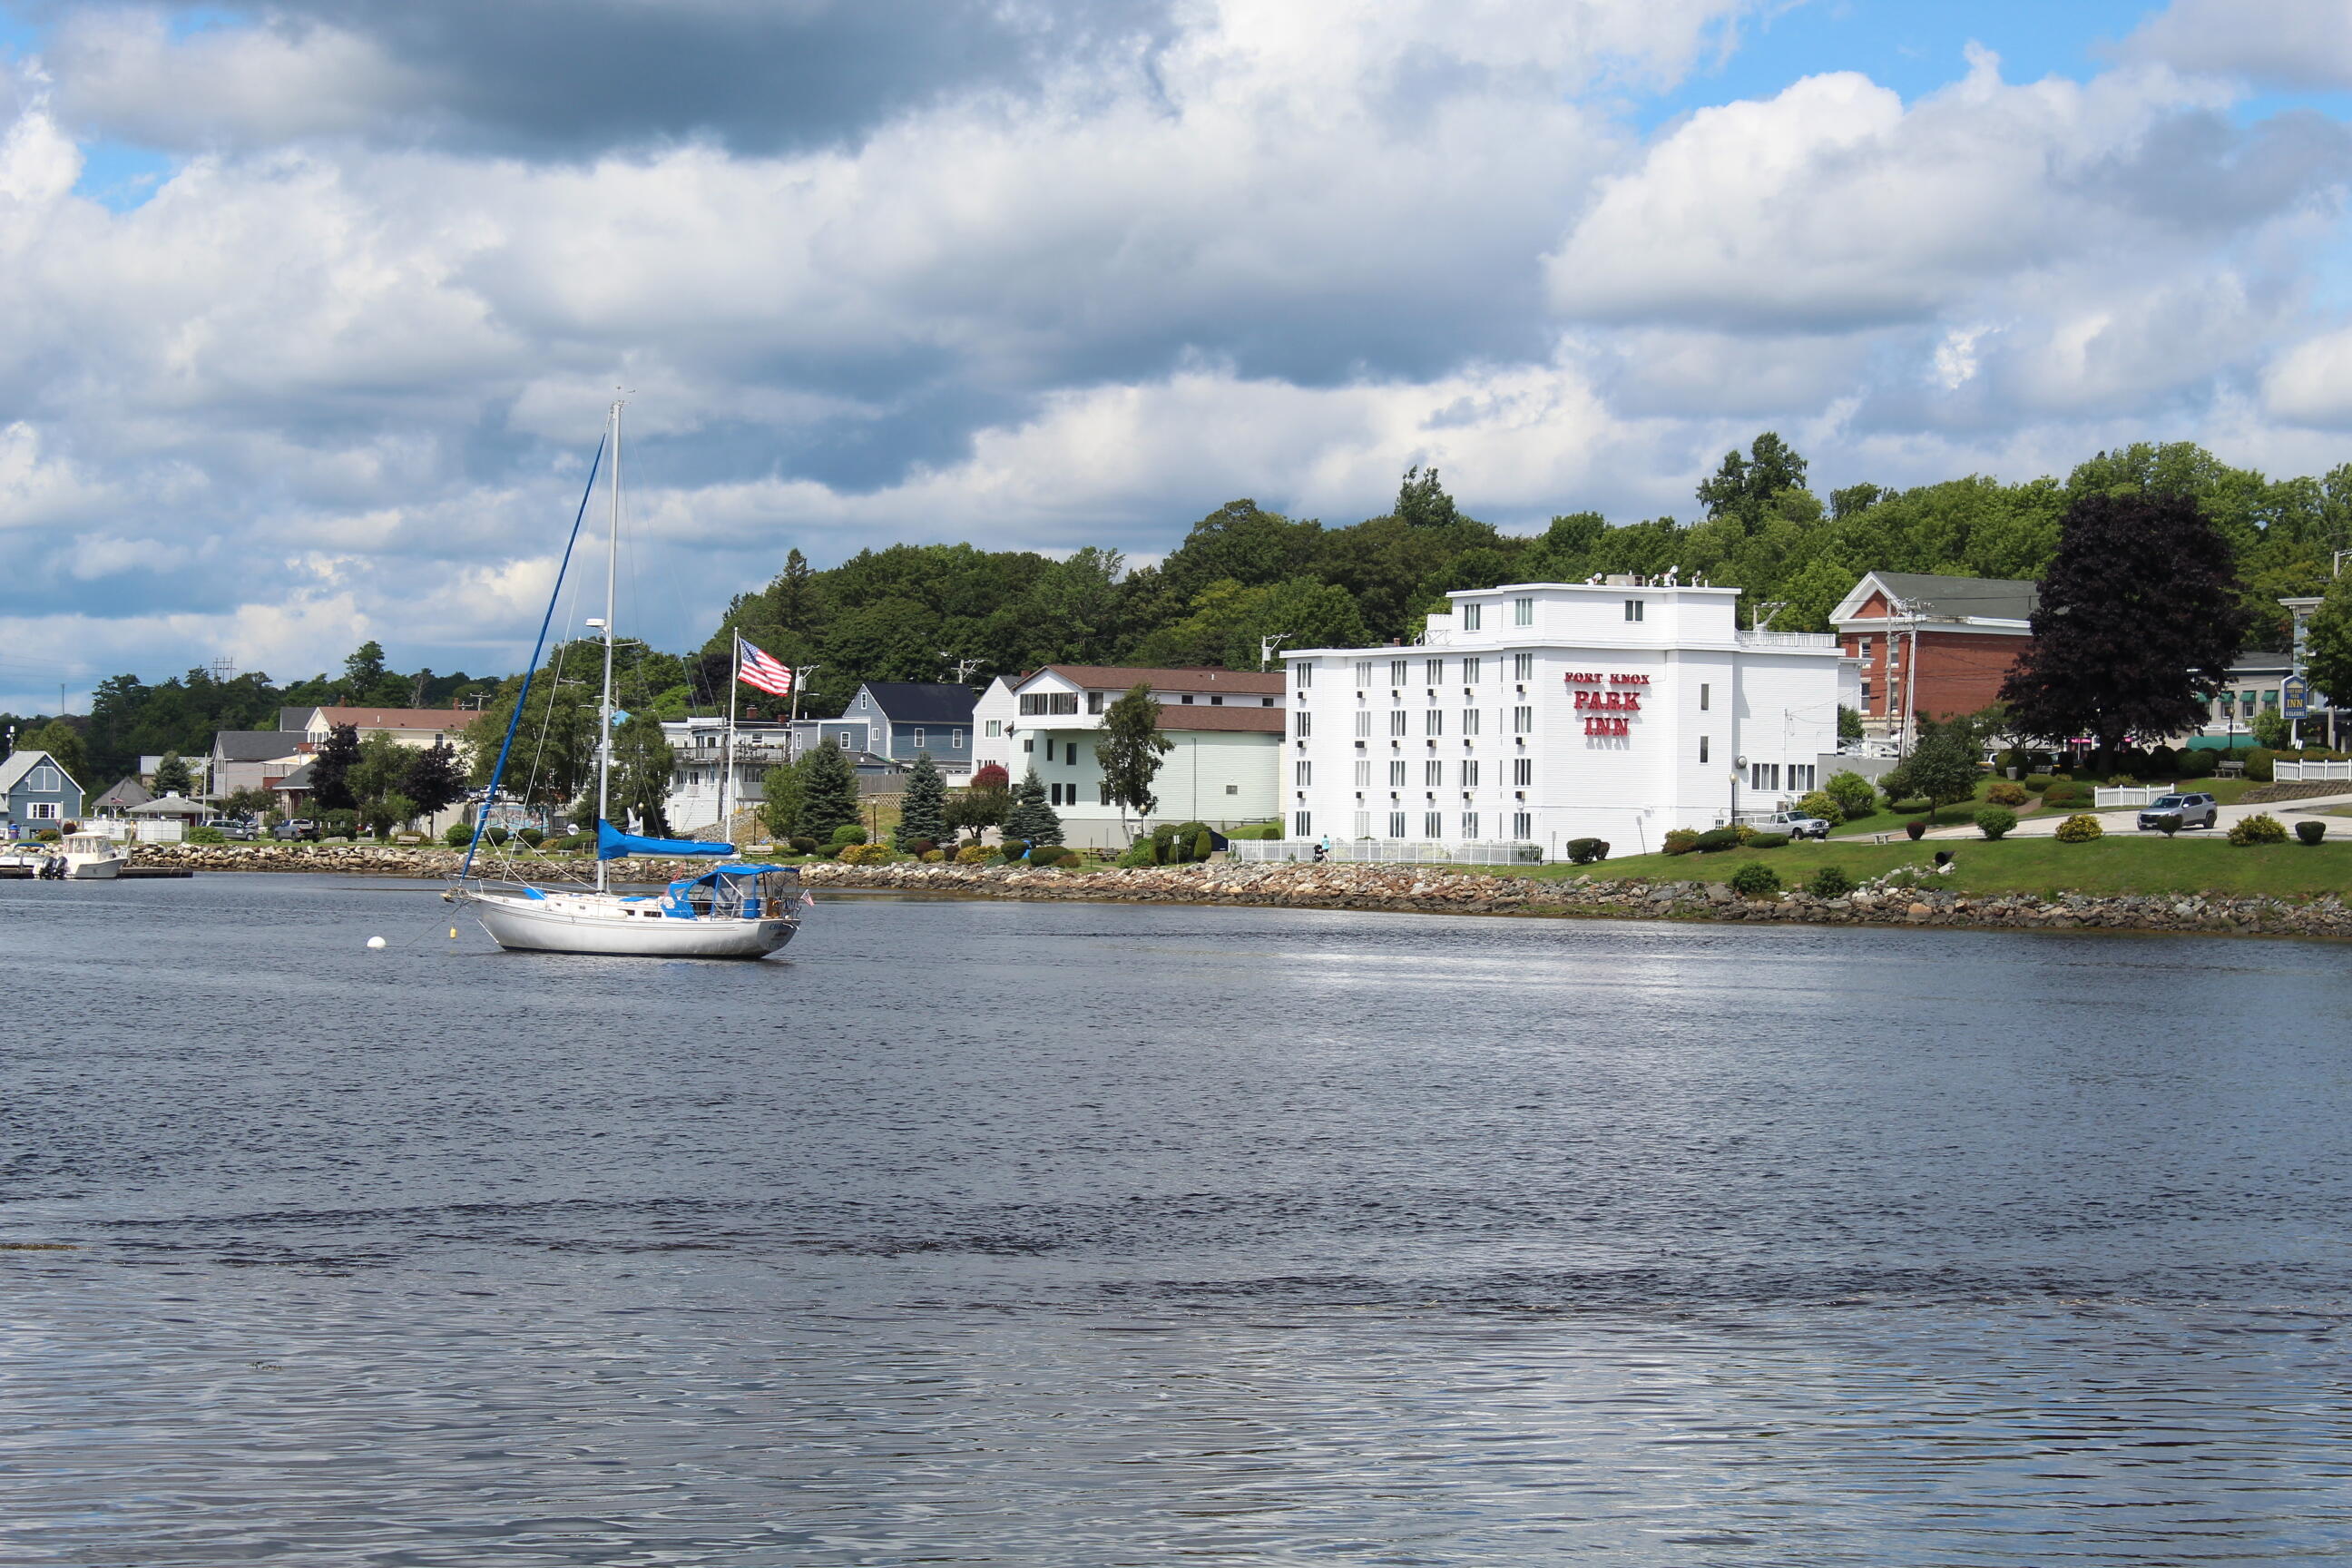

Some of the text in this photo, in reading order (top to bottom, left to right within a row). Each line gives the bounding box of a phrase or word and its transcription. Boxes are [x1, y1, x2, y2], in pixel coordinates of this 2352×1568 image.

[1564, 672, 1650, 684] FORT KNOX
[1573, 691, 1641, 710] PARK
[2287, 700, 2303, 708] INN
[1584, 717, 1629, 736] INN
